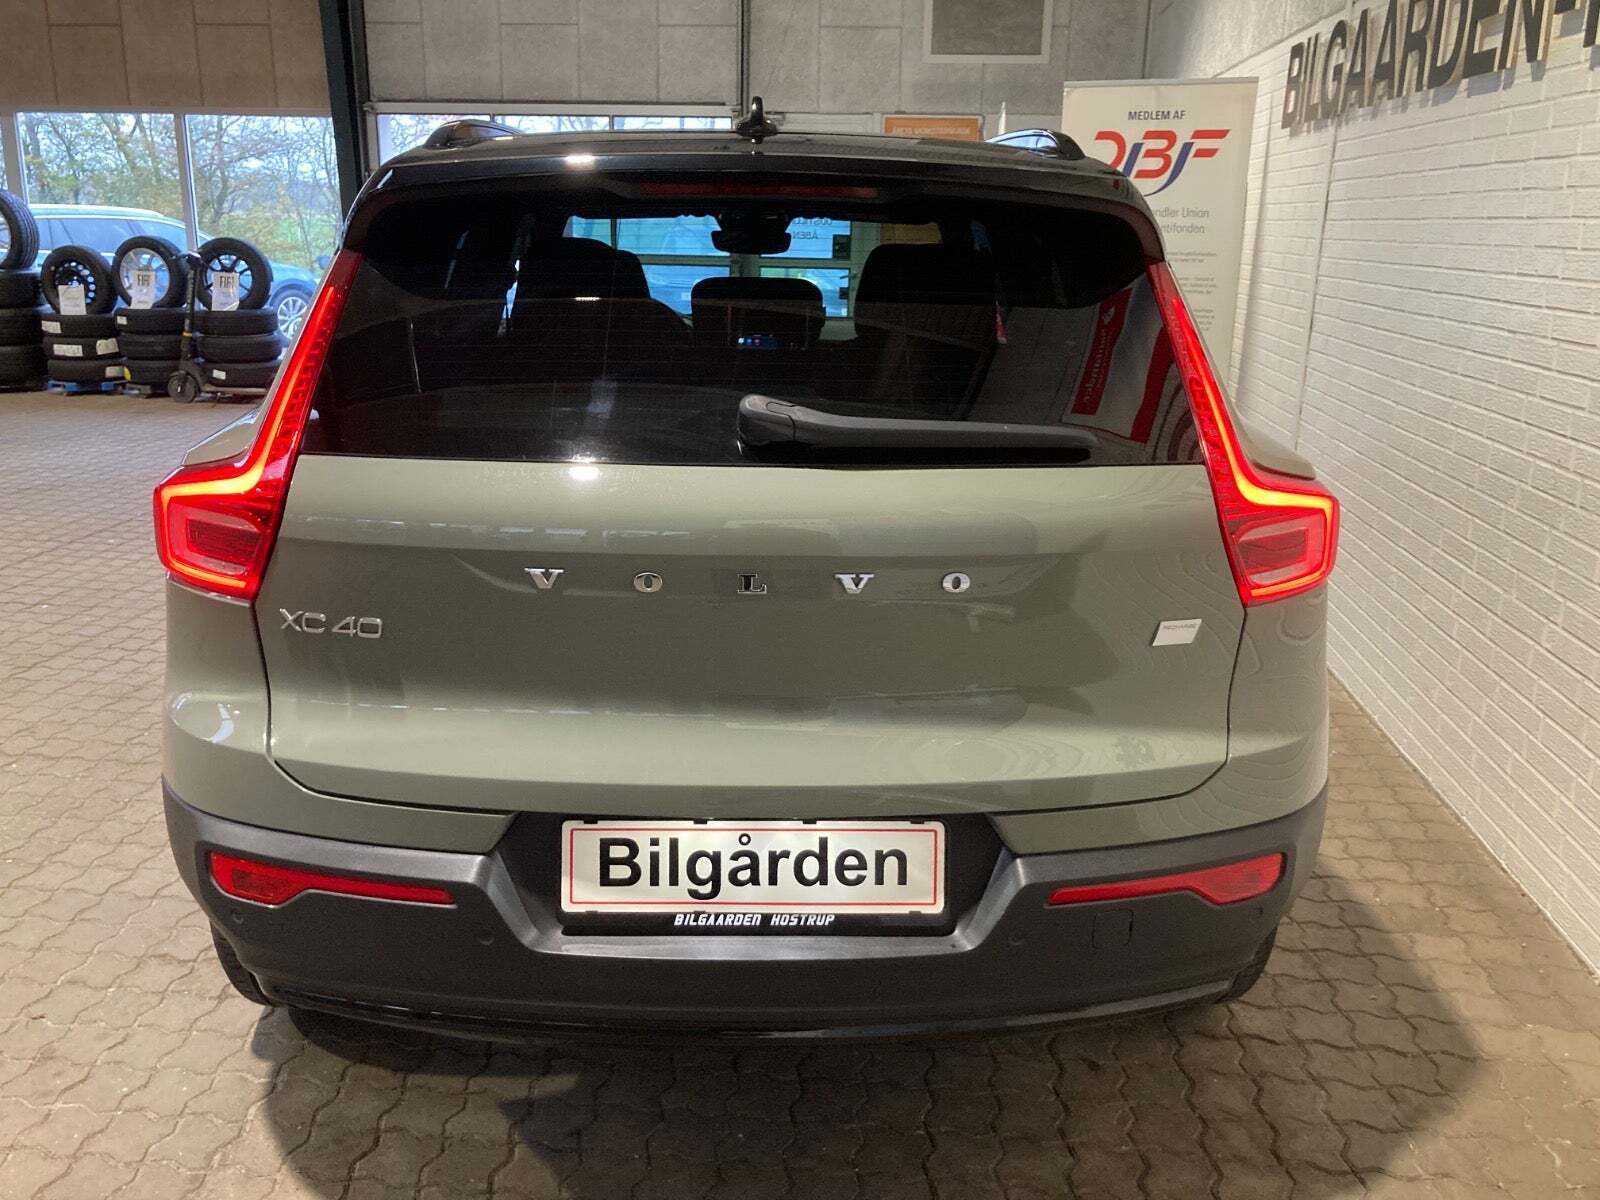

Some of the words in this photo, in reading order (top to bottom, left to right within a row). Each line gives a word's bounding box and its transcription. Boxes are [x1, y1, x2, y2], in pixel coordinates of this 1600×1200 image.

[1281, 0, 1600, 129] BILGAARDEN-
[1128, 111, 1170, 120] MEDLEM
[1173, 110, 1186, 120] AF
[1182, 207, 1210, 218] Union
[524, 567, 971, 594] VOLVO
[599, 833, 907, 900] Bilgården
[674, 913, 762, 926] BILGAARDEN
[770, 914, 835, 926] HOSTRUP
